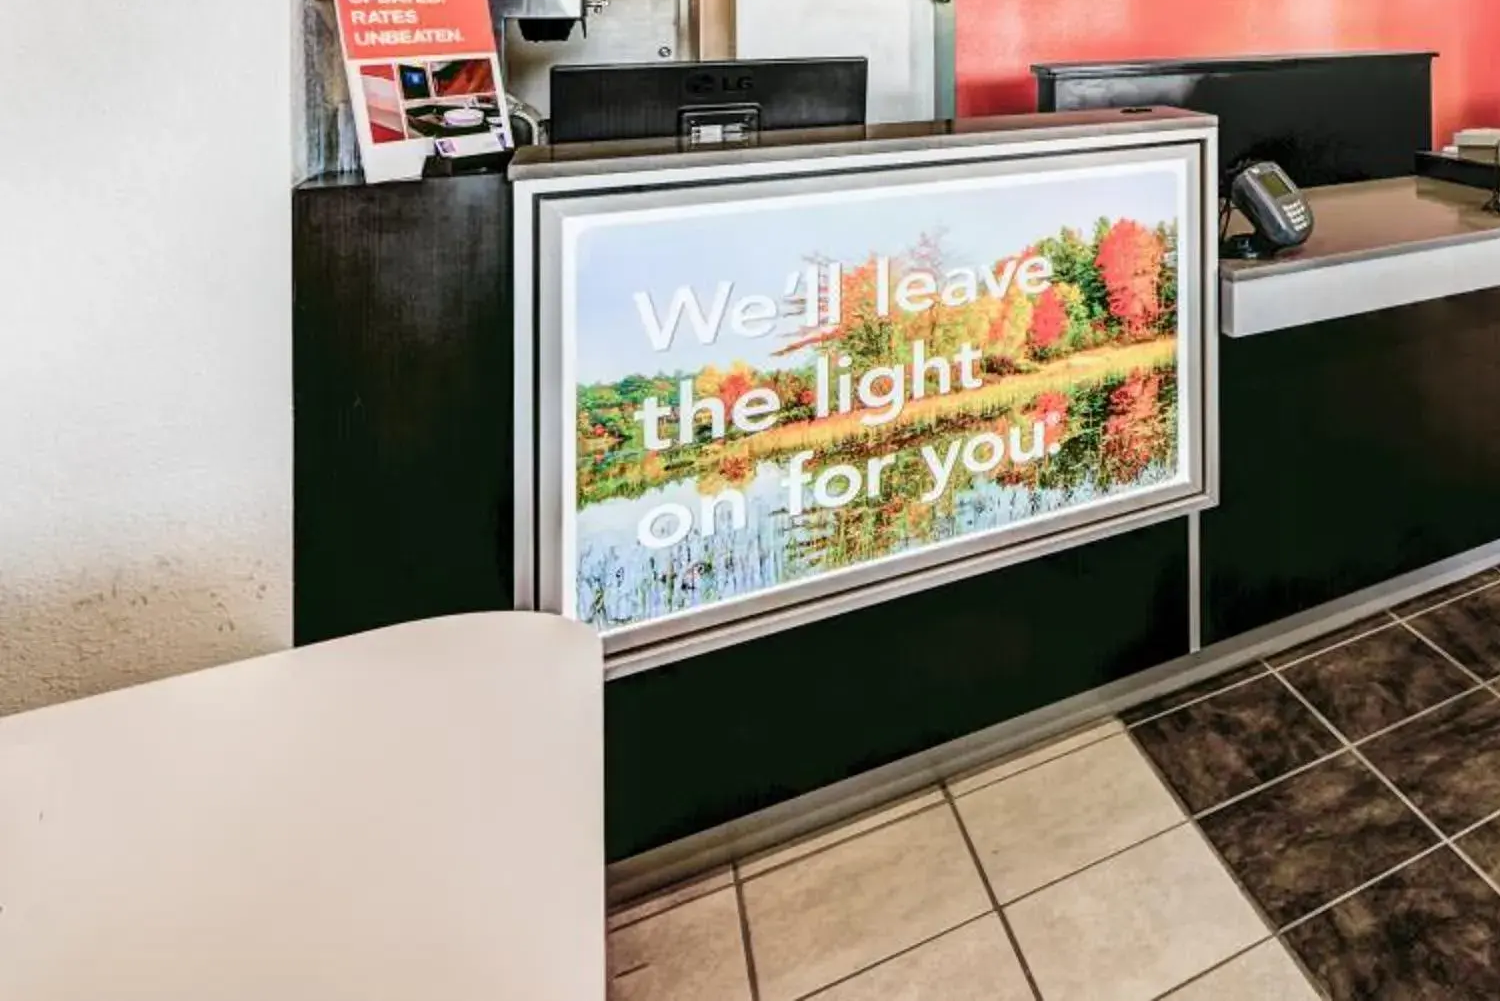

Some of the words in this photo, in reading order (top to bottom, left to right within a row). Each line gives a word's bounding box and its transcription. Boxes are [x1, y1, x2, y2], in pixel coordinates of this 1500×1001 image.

[351, 9, 418, 24] RATES
[354, 28, 465, 47] UNBEATEN.
[722, 76, 753, 91] LG
[633, 256, 841, 352] We'll
[876, 252, 1053, 316] leave
[635, 379, 780, 452] the
[815, 340, 984, 426] light
[637, 491, 746, 550] on
[779, 451, 898, 517] for
